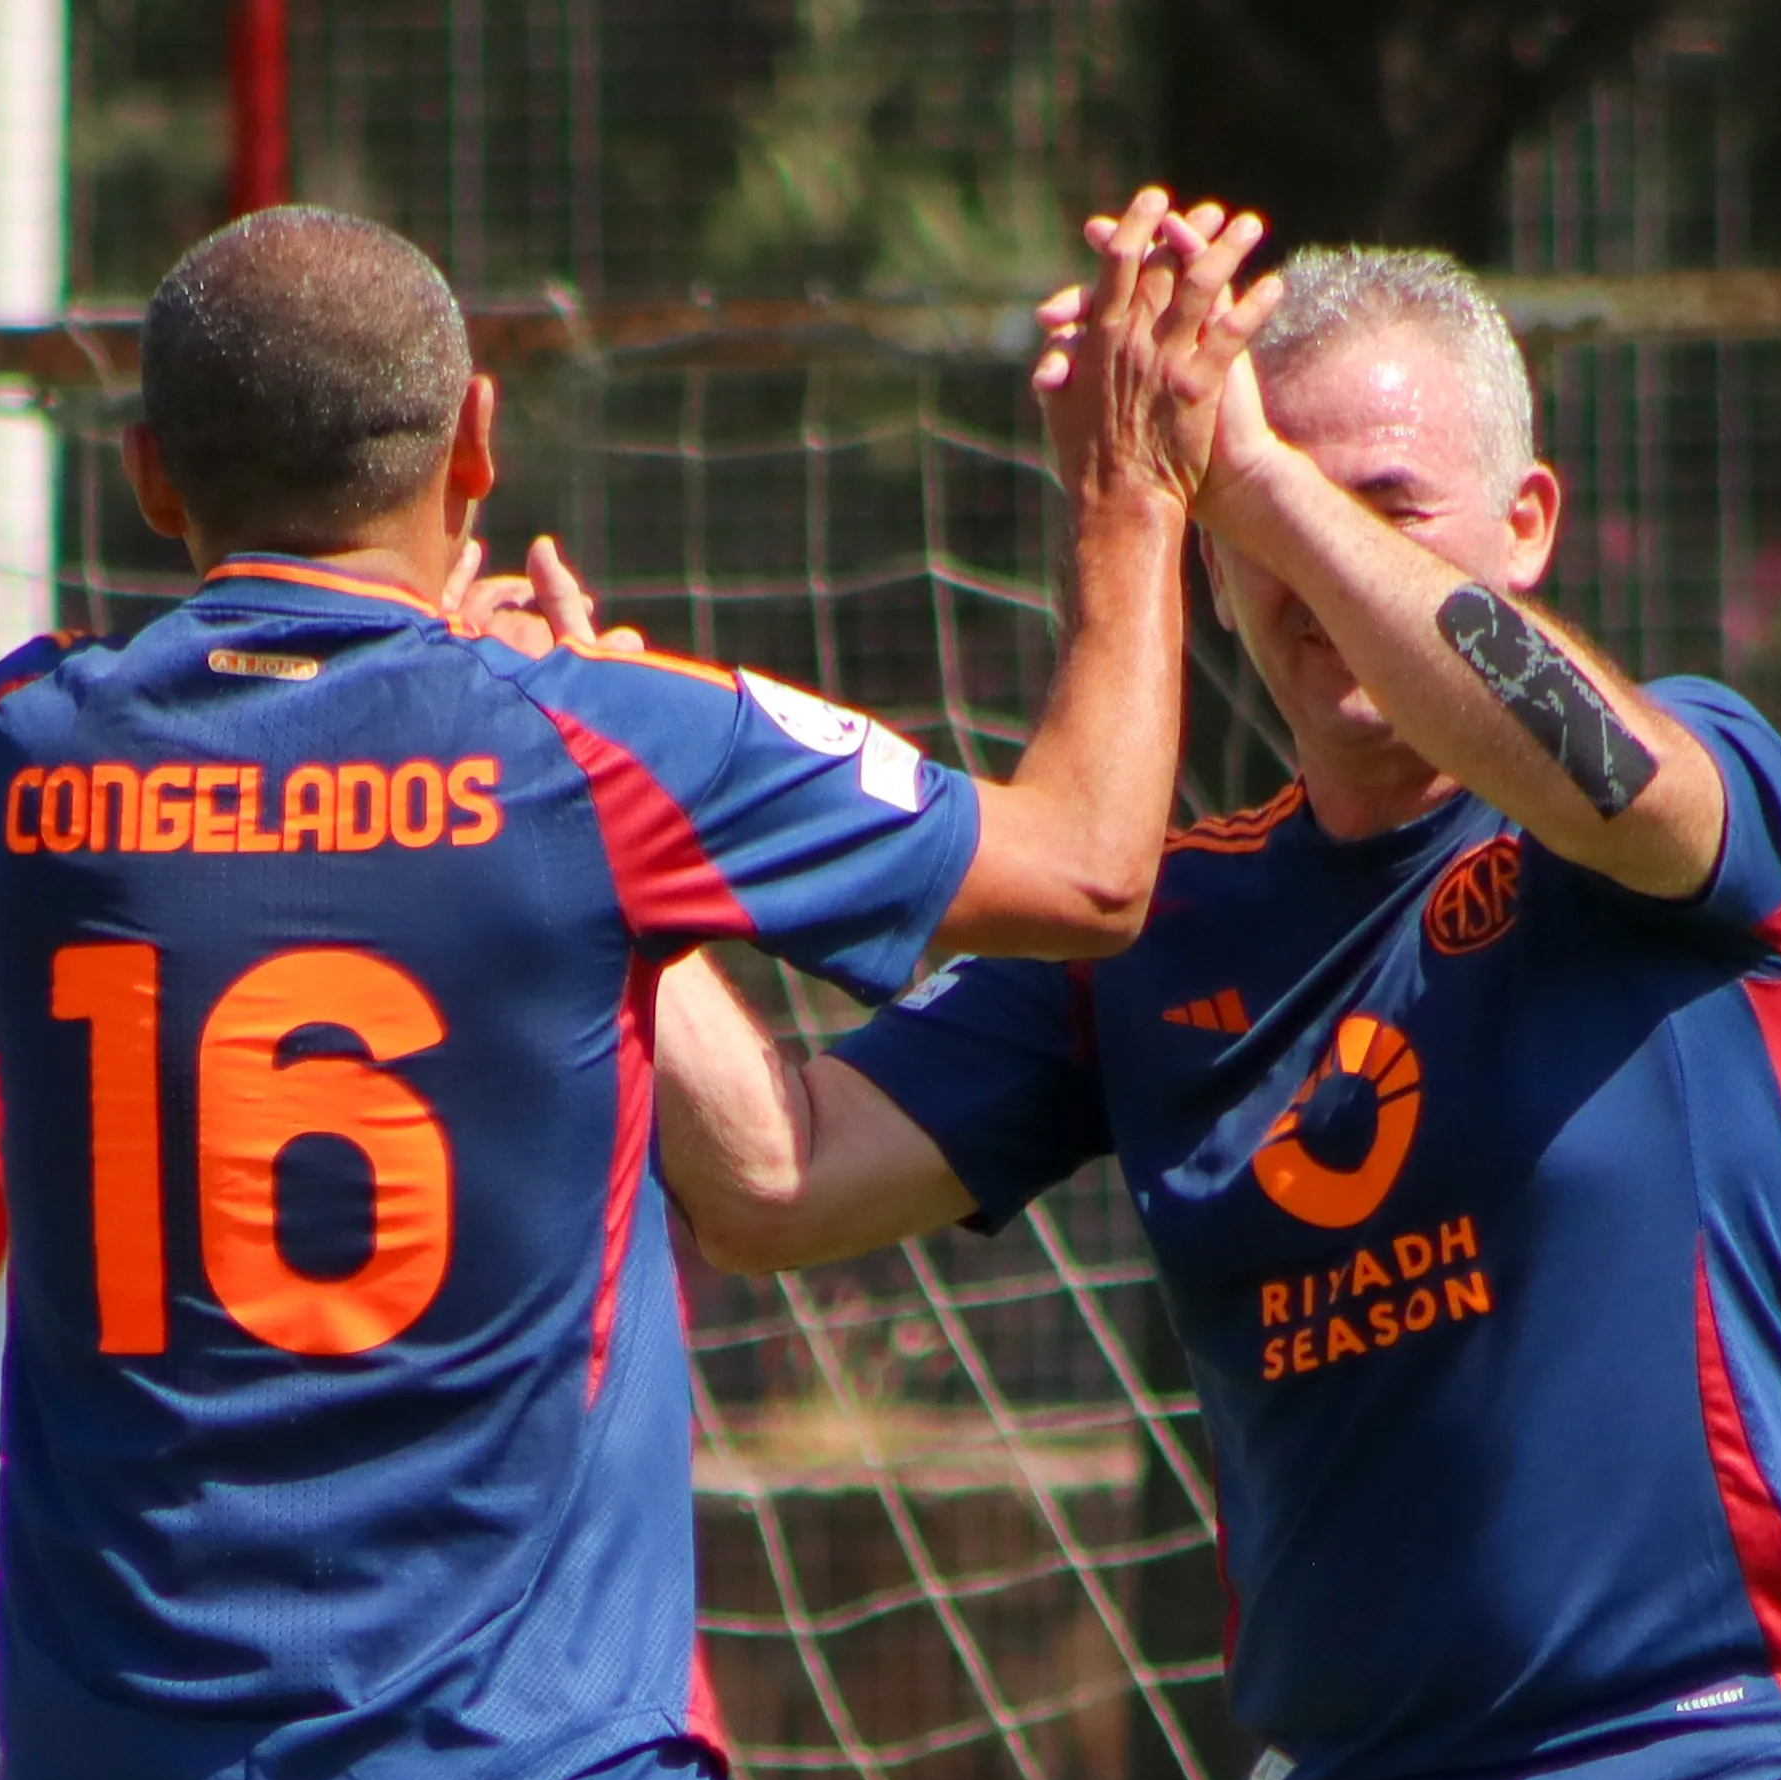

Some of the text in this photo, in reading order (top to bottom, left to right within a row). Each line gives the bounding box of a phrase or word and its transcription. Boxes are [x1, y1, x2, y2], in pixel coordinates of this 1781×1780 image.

[5, 759, 501, 854] CONGELADOS
[1434, 848, 1519, 939] ASR
[51, 943, 453, 1356] 16
[1262, 1215, 1477, 1328] RIYADH
[1262, 1271, 1490, 1380] SEASON
